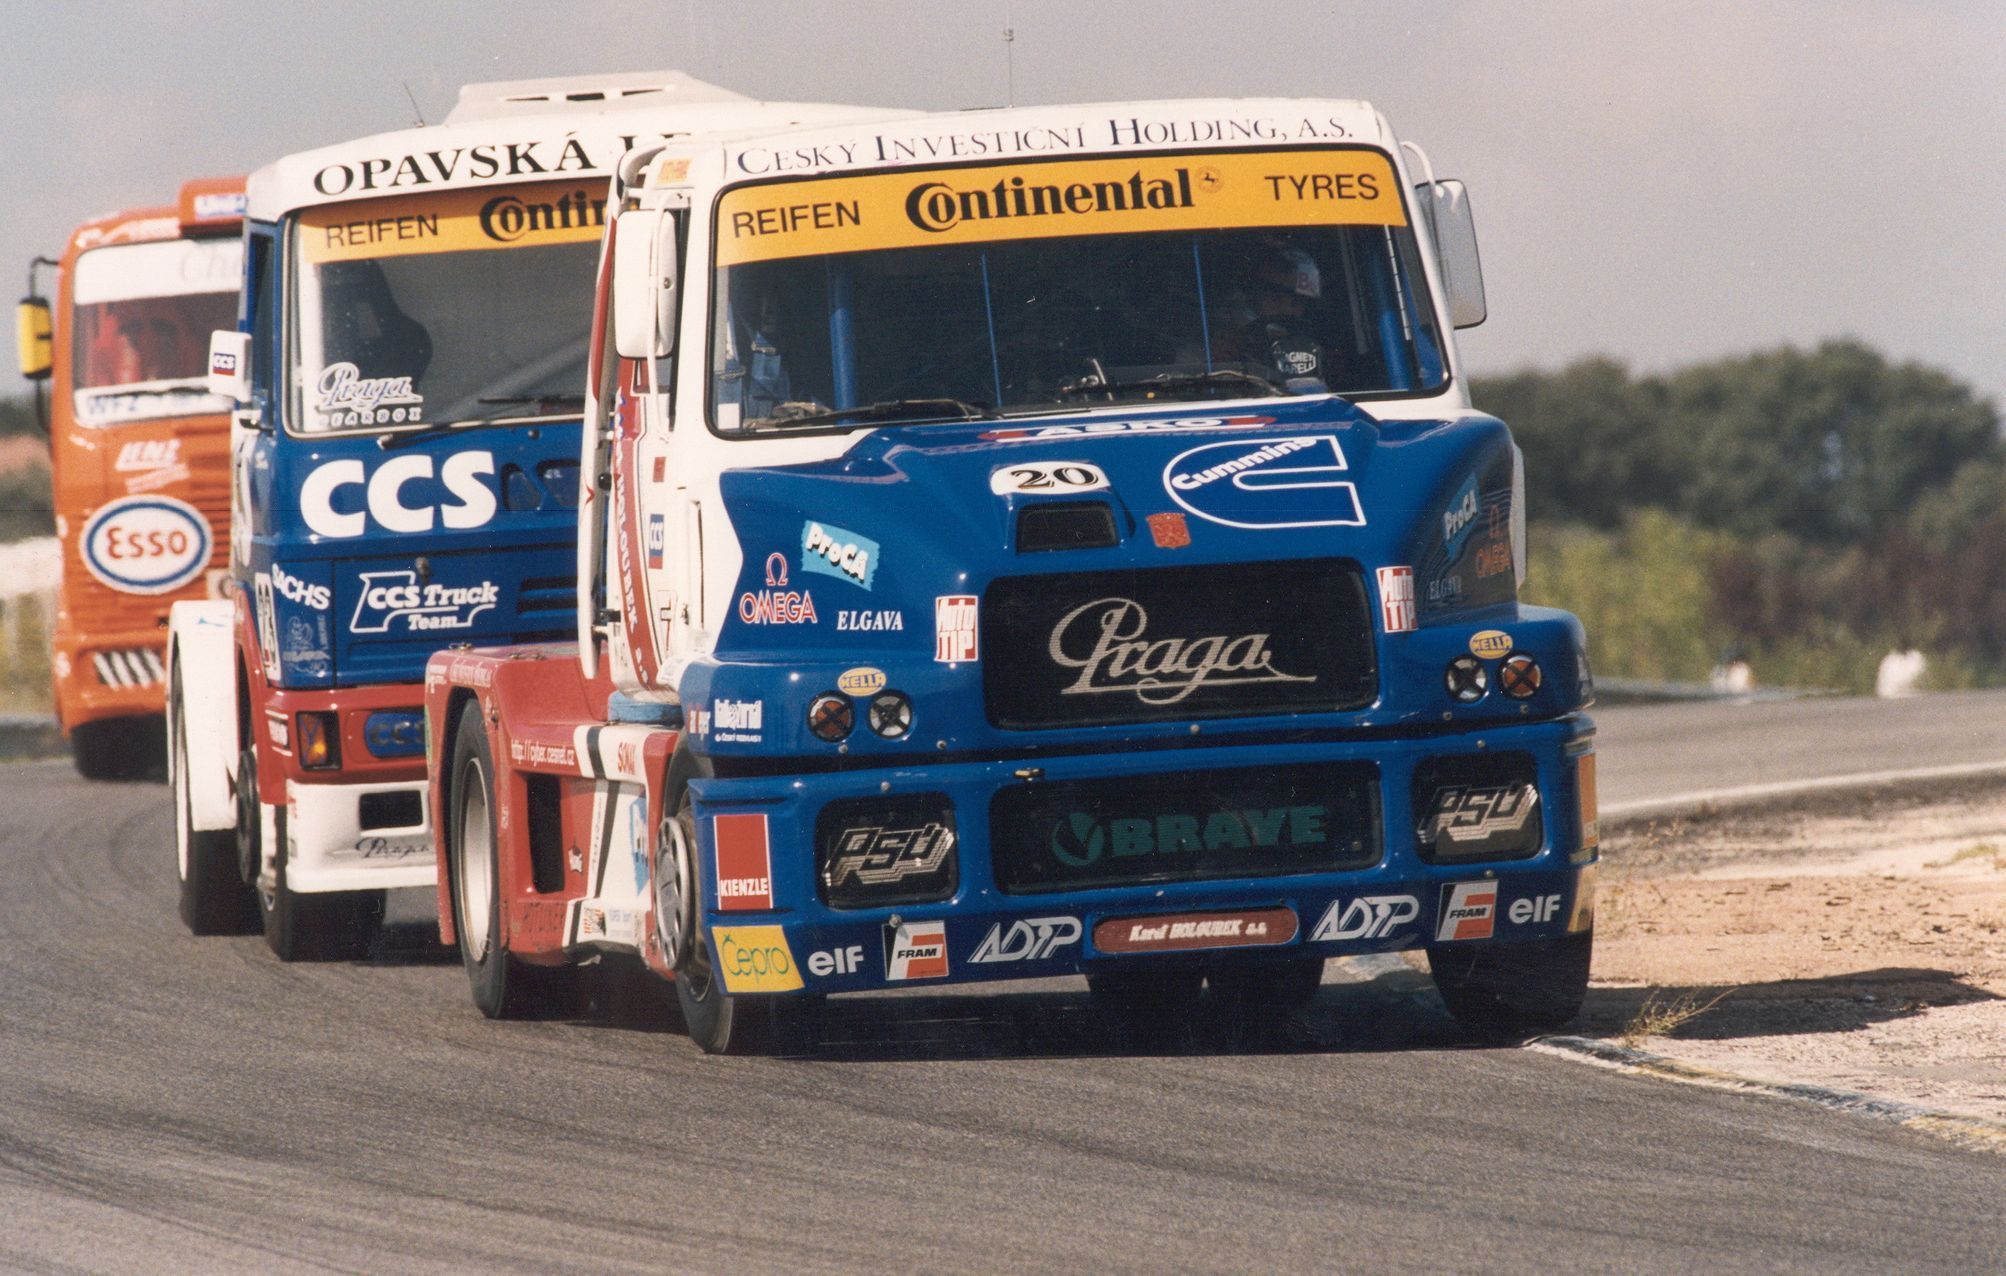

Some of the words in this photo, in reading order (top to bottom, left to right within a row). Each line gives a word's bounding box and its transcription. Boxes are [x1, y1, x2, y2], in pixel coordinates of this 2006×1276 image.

[1298, 117, 1354, 138] A.S.
[313, 132, 597, 196] OPAVSKÁ
[733, 200, 861, 238] REIFEN
[905, 168, 1195, 233] Continental
[1264, 173, 1380, 202] TYRES
[326, 213, 440, 249] REIFEN
[213, 354, 234, 370] CCS
[318, 362, 424, 413] Praga
[1037, 417, 1223, 437] ASKO
[1011, 466, 1099, 490] 20
[1171, 437, 1317, 490] Cummins
[300, 451, 496, 538] CCS
[806, 522, 869, 584] ProCA
[272, 563, 331, 610] SACHS
[367, 587, 420, 609] CCS
[424, 581, 499, 607] Truck
[408, 613, 457, 631] Team
[739, 590, 818, 626] OMEGA
[836, 610, 904, 631] ELGAVA
[938, 631, 974, 660] TIP
[1050, 598, 1317, 704] Praga
[1471, 634, 1511, 650] HELLA
[841, 671, 884, 689] HELLA
[1112, 805, 1328, 857] BRAVE
[720, 878, 769, 897] KIENZLE
[1449, 907, 1488, 919] FRAM
[1508, 894, 1561, 924] elf
[808, 945, 864, 977] elf
[897, 948, 938, 960] FRAM
